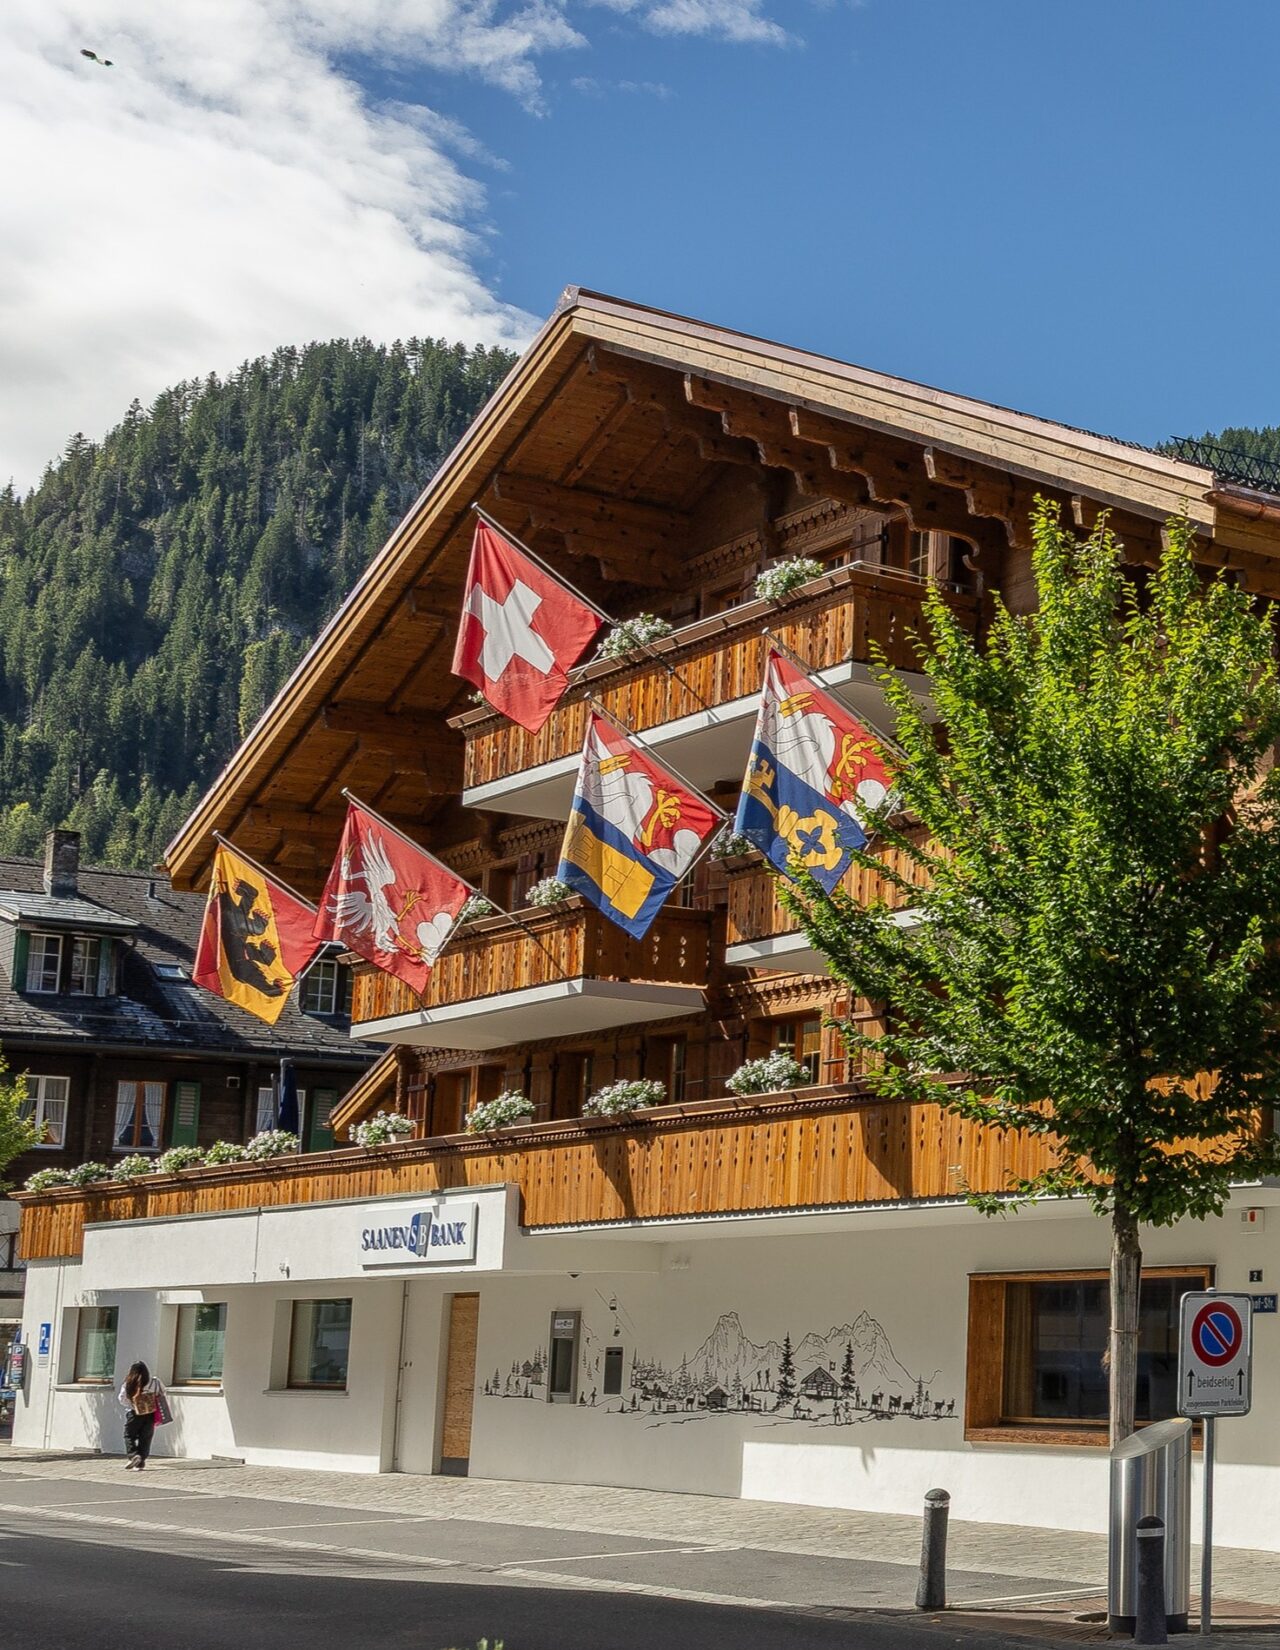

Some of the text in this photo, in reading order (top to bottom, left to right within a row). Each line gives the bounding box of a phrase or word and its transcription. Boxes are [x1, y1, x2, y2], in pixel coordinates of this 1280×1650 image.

[362, 1226, 409, 1251] SAANEN
[431, 1222, 467, 1247] BANK
[1253, 1271, 1258, 1281] 2
[1197, 1375, 1235, 1390] beidseitig
